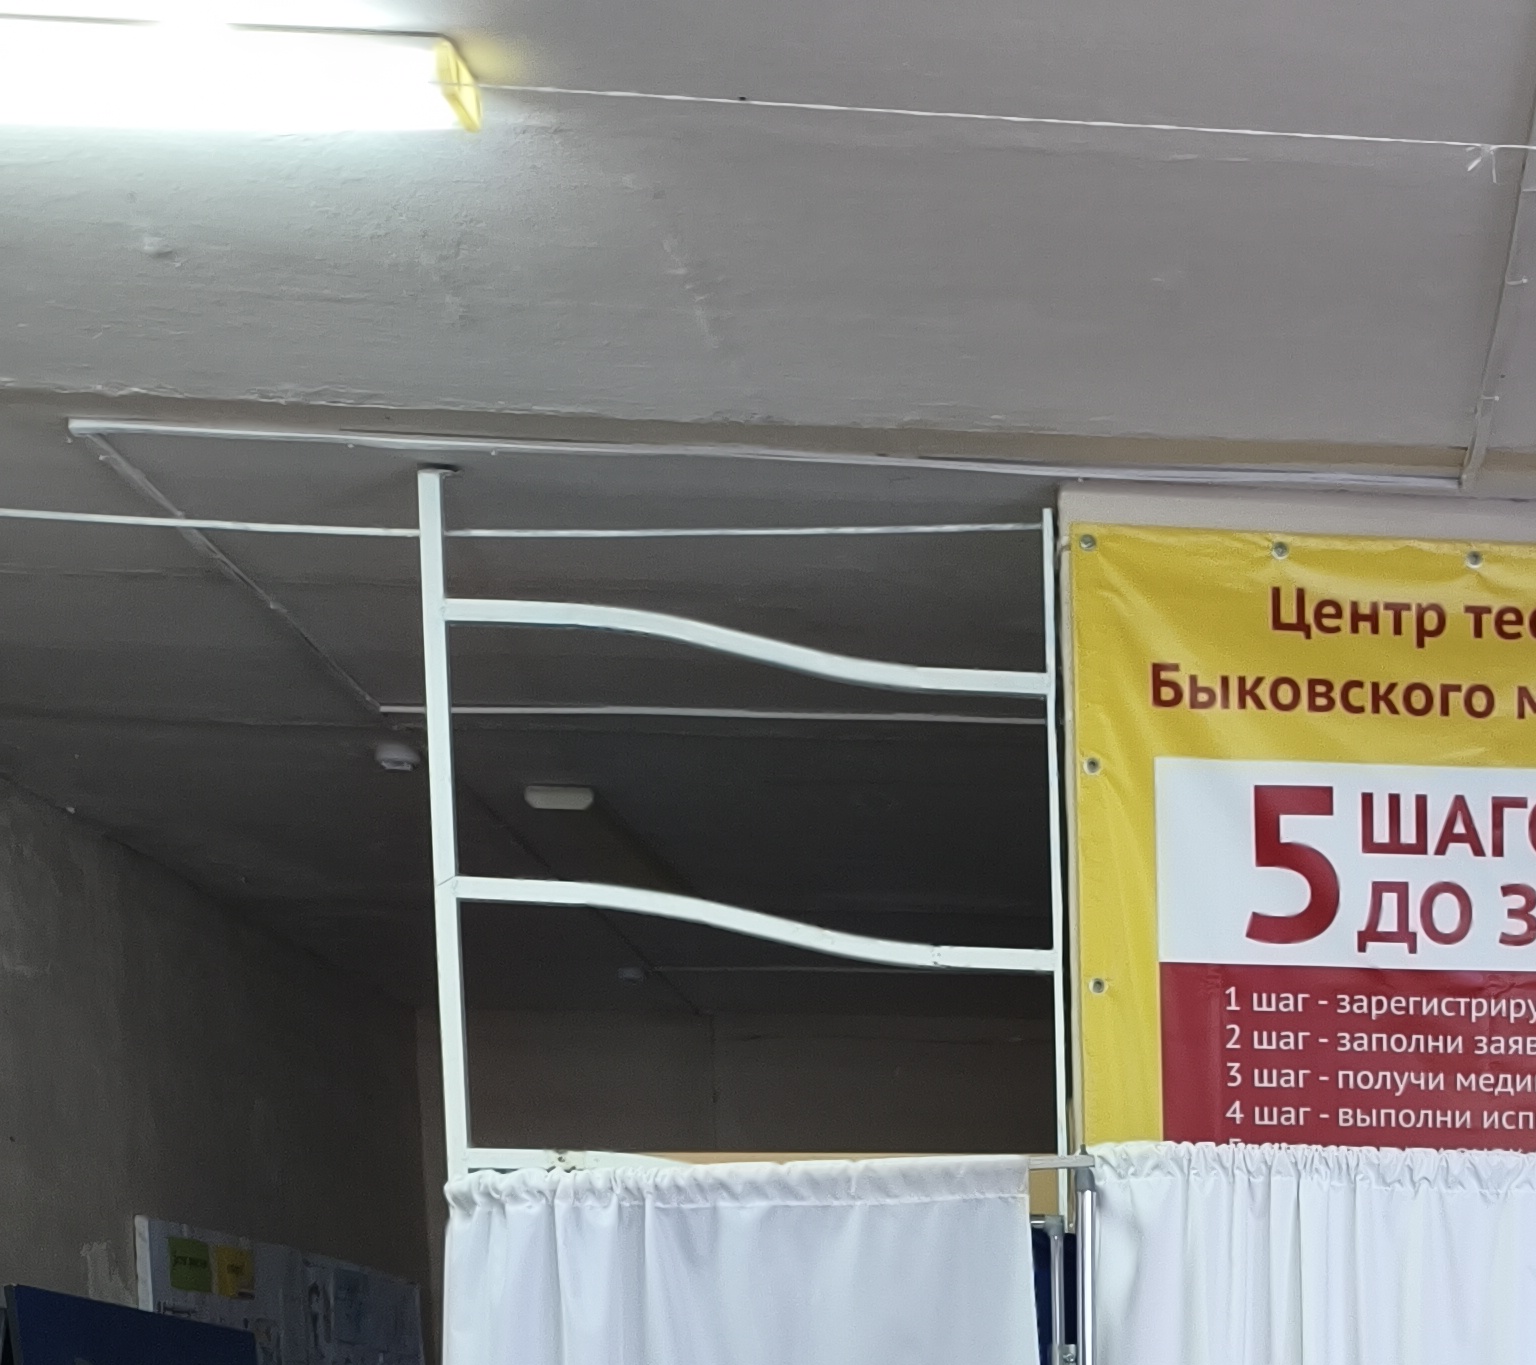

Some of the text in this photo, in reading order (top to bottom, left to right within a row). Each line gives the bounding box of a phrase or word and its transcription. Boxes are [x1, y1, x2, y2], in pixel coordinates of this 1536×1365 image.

[1270, 586, 1447, 647] Центр
[1150, 663, 1496, 719] Быковского
[1244, 784, 1341, 946] 5
[1357, 881, 1474, 954] ДО
[1224, 986, 1241, 1011] 1
[1252, 991, 1311, 1013] шаг
[1225, 1024, 1241, 1049] 2
[1252, 1030, 1311, 1051] шаг
[1336, 1031, 1463, 1054] заполни
[1226, 1062, 1242, 1087] 3
[1253, 1068, 1311, 1089] шаг
[1337, 1069, 1445, 1096] получи
[1225, 1100, 1244, 1125] 4
[1254, 1105, 1311, 1127] шаг
[1338, 1107, 1471, 1129] выполни
